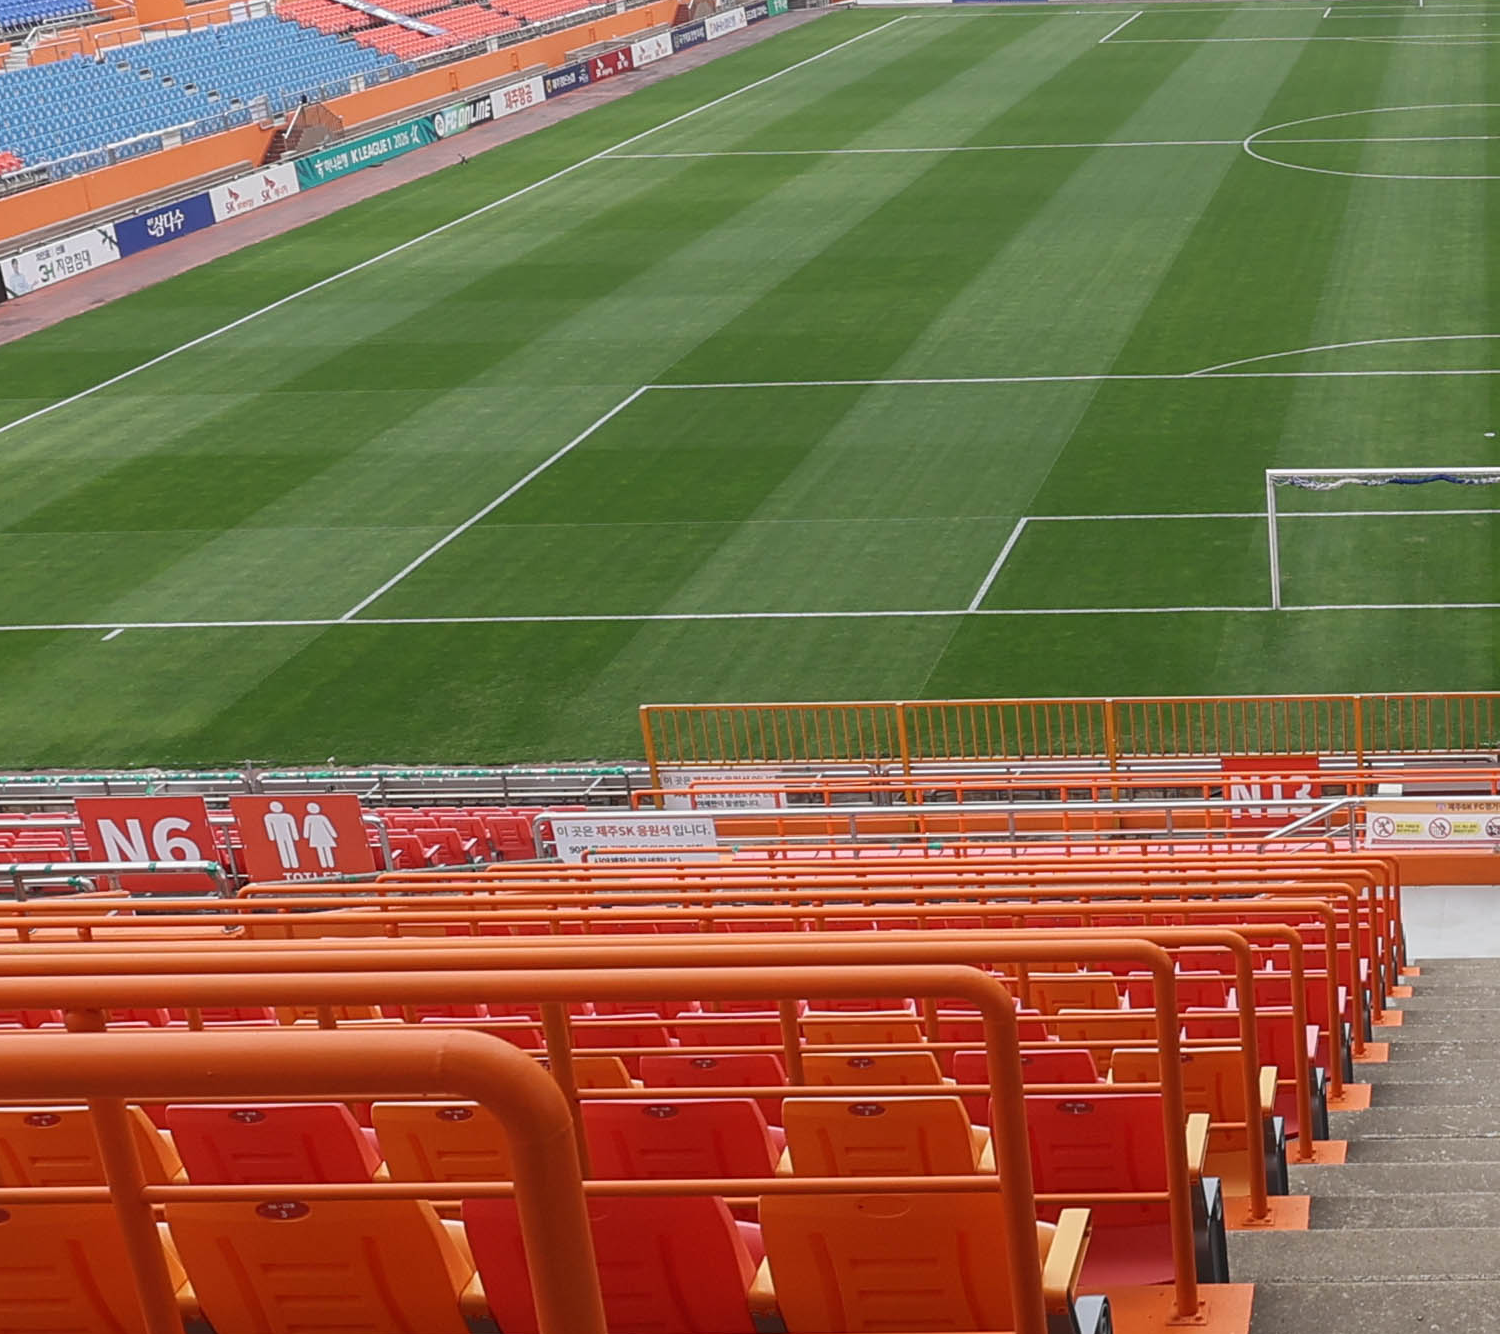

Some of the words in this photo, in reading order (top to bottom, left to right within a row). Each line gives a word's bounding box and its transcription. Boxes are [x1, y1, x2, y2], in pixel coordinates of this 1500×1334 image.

[97, 816, 200, 863] N6
[556, 825, 569, 837] 이
[571, 825, 595, 837] 곳은
[596, 825, 635, 838] 제주SK
[636, 824, 671, 836] 응원석
[674, 824, 711, 837] 입니다.
